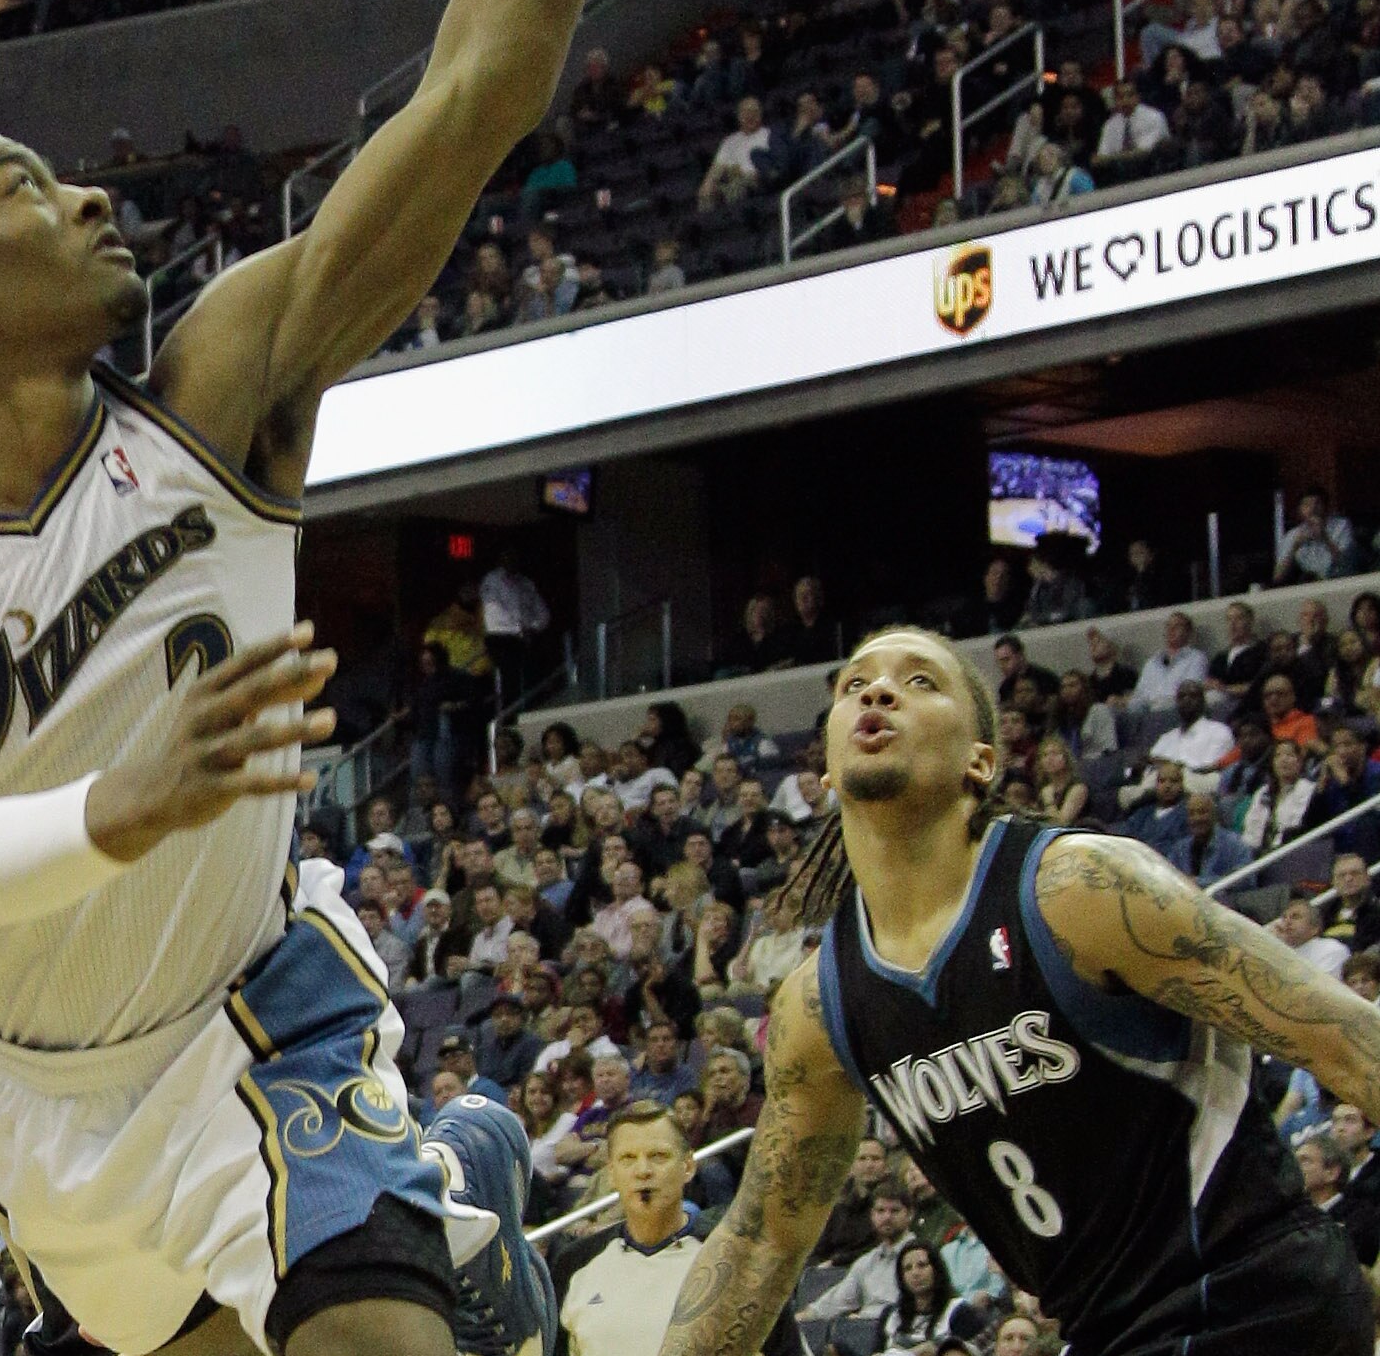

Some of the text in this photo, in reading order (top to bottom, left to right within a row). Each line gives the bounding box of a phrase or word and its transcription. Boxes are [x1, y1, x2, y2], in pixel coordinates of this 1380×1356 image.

[1029, 181, 1377, 300] WE LOGISTICS
[935, 267, 993, 328] ups
[869, 1010, 1082, 1152] WOLVES
[987, 1140, 1064, 1238] 8
